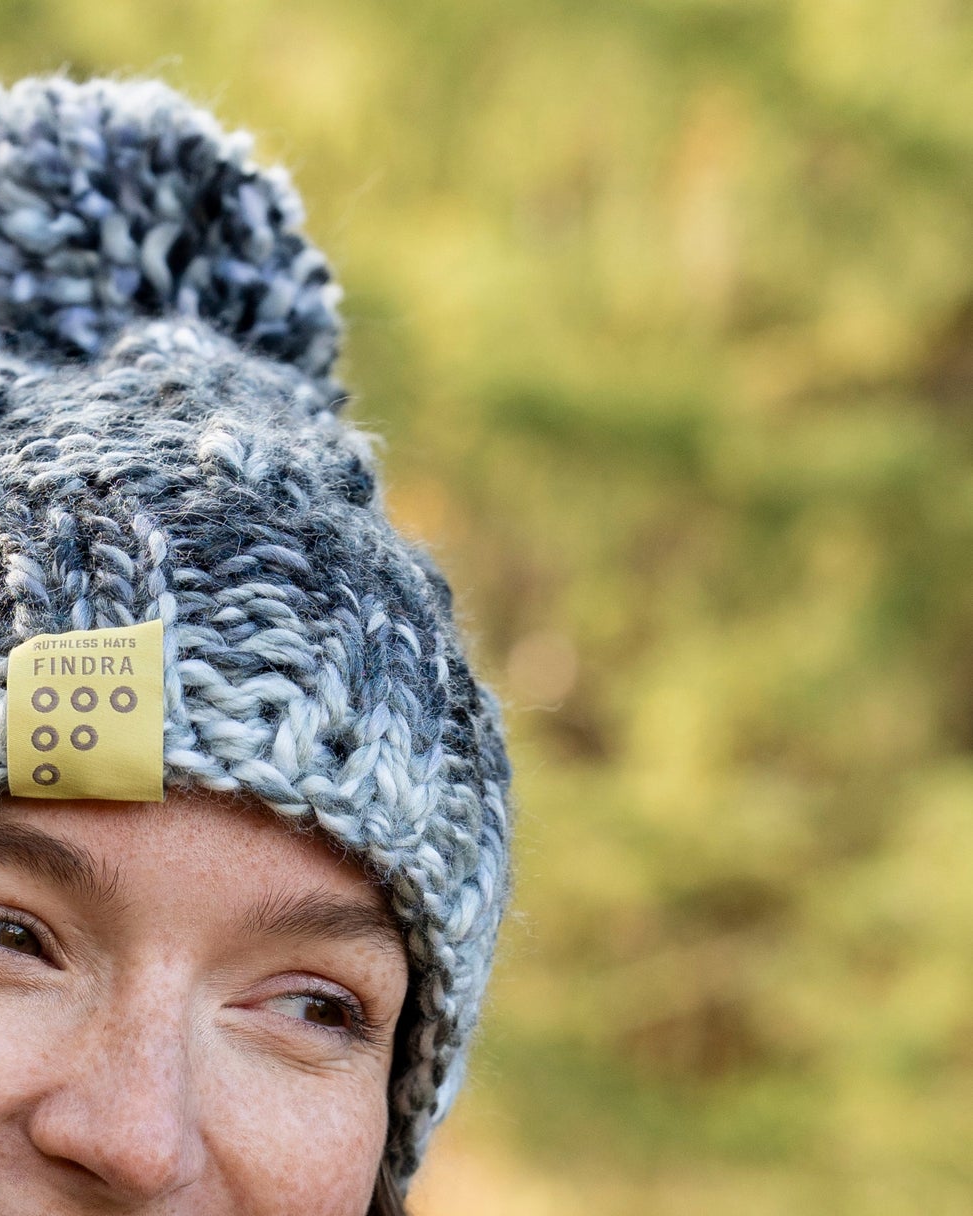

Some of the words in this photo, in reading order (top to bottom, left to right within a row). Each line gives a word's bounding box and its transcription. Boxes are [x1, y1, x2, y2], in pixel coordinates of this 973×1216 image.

[34, 638, 98, 650] RUTHLESS
[103, 638, 136, 648] HATS
[33, 656, 135, 676] FINDRA
